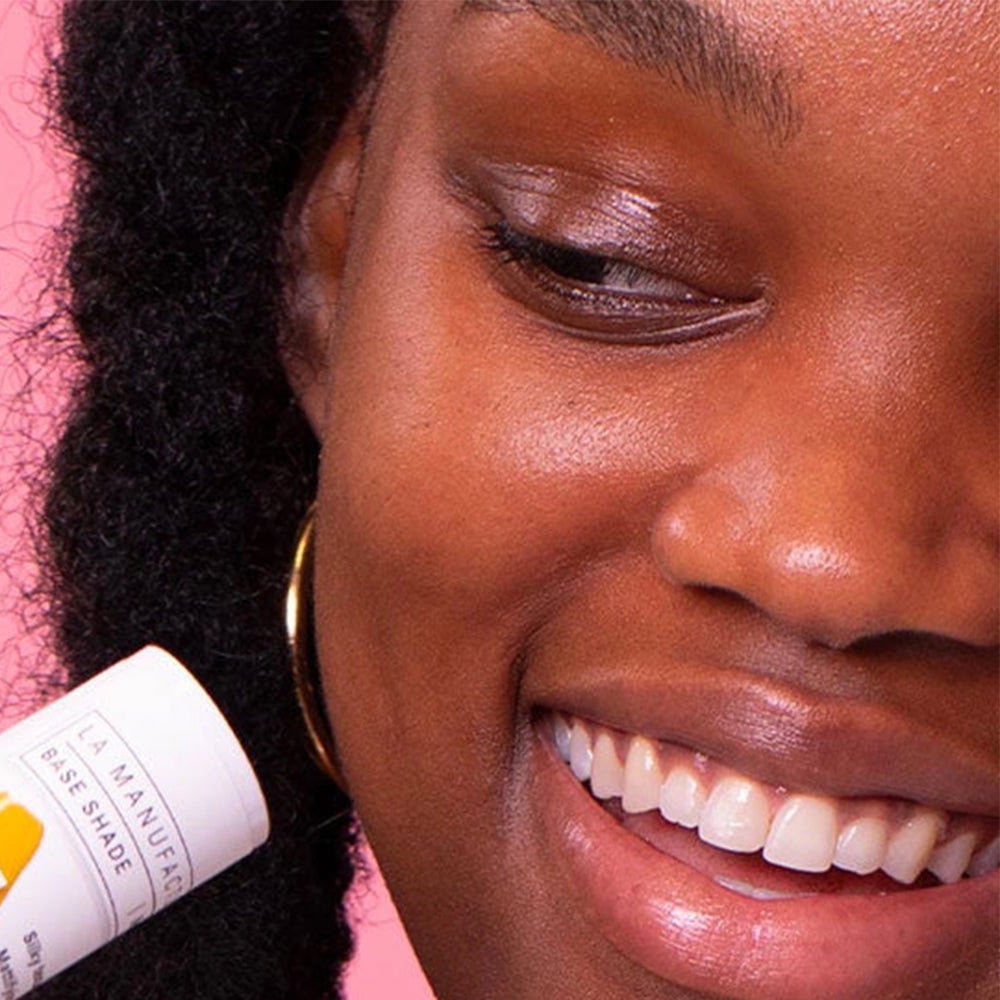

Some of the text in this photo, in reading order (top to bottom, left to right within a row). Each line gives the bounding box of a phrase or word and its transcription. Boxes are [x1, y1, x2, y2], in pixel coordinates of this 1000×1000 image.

[77, 724, 108, 756] LA
[40, 747, 133, 876] BASE SHADE
